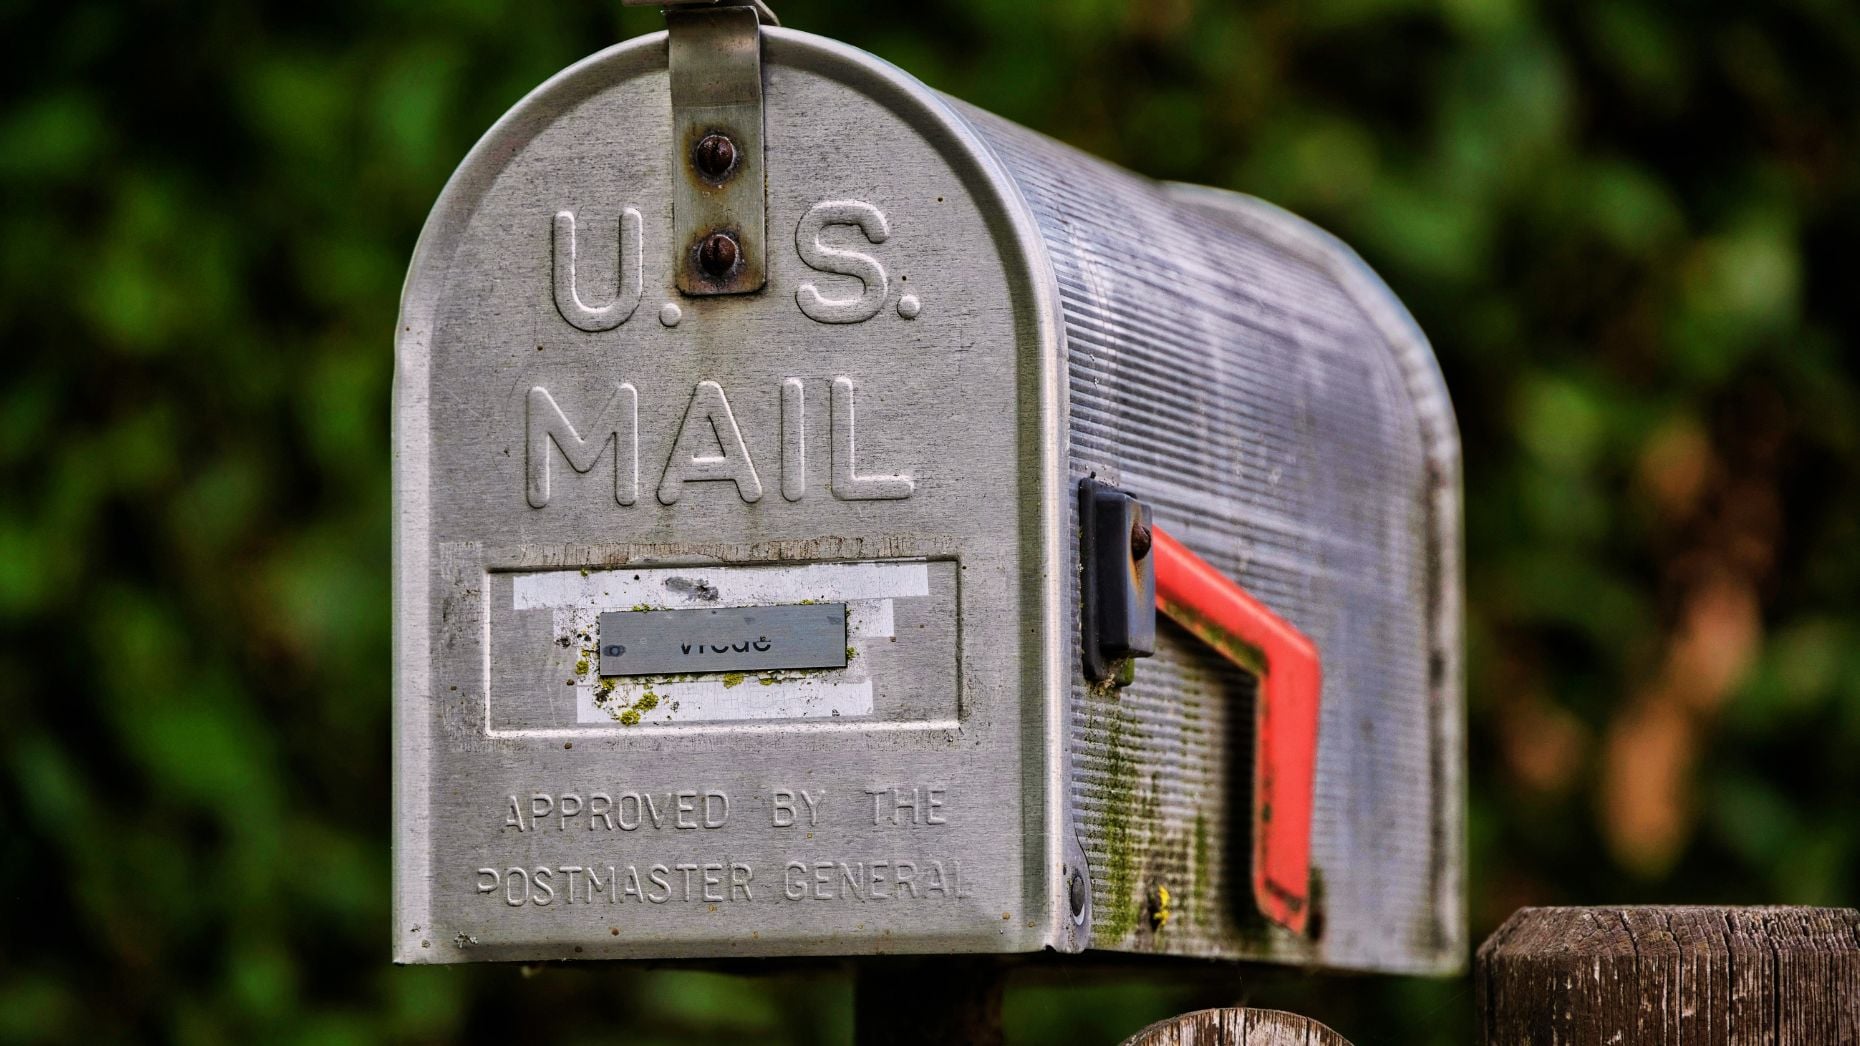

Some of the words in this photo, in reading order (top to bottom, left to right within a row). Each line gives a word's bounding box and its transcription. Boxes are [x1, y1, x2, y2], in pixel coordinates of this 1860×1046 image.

[526, 375, 915, 508] MAIL
[501, 789, 730, 833] APPROVED
[772, 788, 825, 828] BY
[865, 788, 947, 825] THE
[476, 863, 753, 906] POSTMASTER
[783, 860, 971, 901] GENERAL
